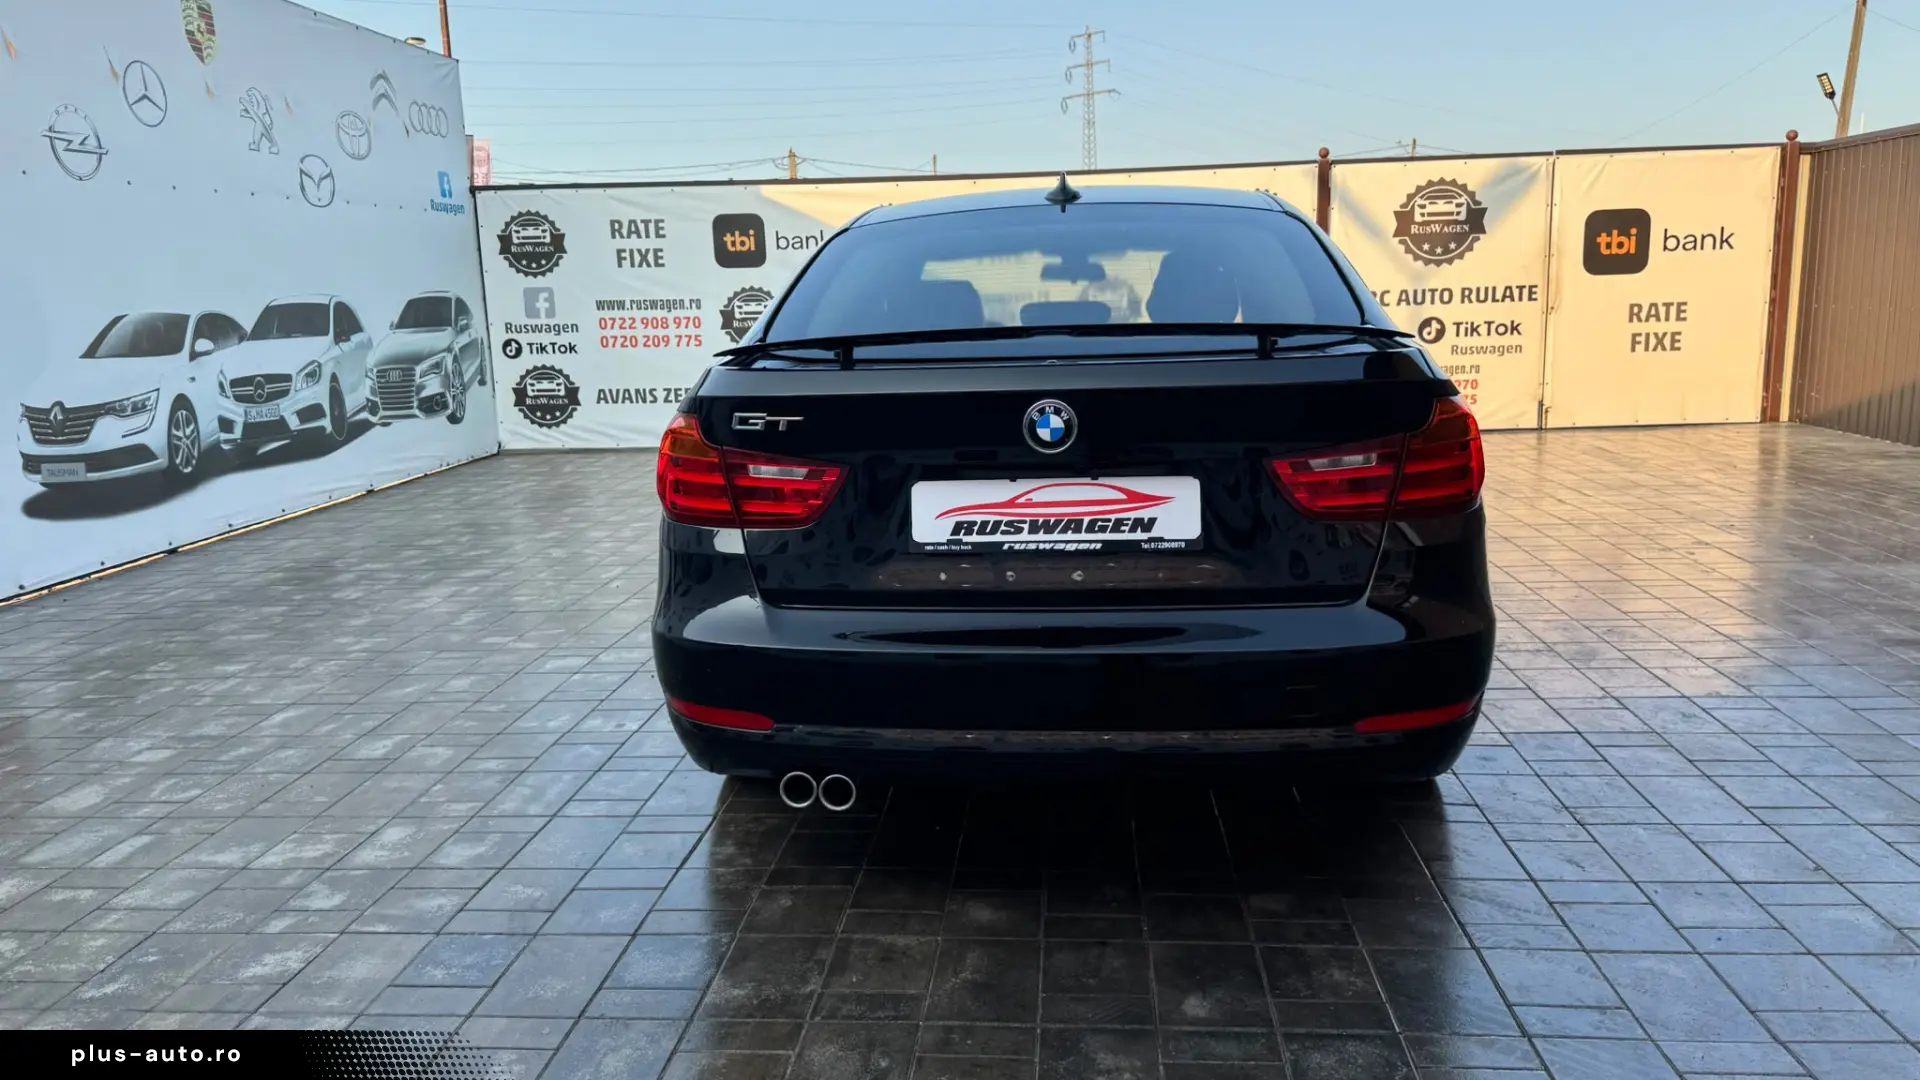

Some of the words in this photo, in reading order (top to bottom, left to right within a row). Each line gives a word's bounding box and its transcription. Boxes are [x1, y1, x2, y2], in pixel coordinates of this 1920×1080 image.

[430, 199, 465, 215] Ruswagen
[609, 219, 666, 239] RATE
[723, 229, 756, 251] tbi
[1597, 228, 1637, 255] tbi
[1662, 226, 1735, 252] bank
[616, 248, 666, 268] FIXE
[1396, 287, 1454, 307] AUTO
[1460, 285, 1539, 304] RULATE
[595, 298, 702, 313] www.ruswagen.ro
[1628, 301, 1689, 323] RATE
[505, 322, 579, 336] Ruswagen
[599, 317, 637, 330] 0722
[640, 316, 669, 329] 908
[673, 316, 701, 329] 970
[1452, 320, 1523, 337] TikTok
[526, 342, 578, 355] TikTok
[600, 335, 638, 348] 0720
[642, 335, 670, 348] 209
[675, 334, 702, 347] 775
[1630, 331, 1682, 352] FIXE
[1451, 344, 1523, 357] Ruswagen
[596, 388, 657, 404] AVANS
[731, 412, 804, 431] GT
[1031, 406, 1069, 421] BMW
[950, 517, 1157, 537] RUSWAGEN
[1002, 541, 1103, 551] ruswagen
